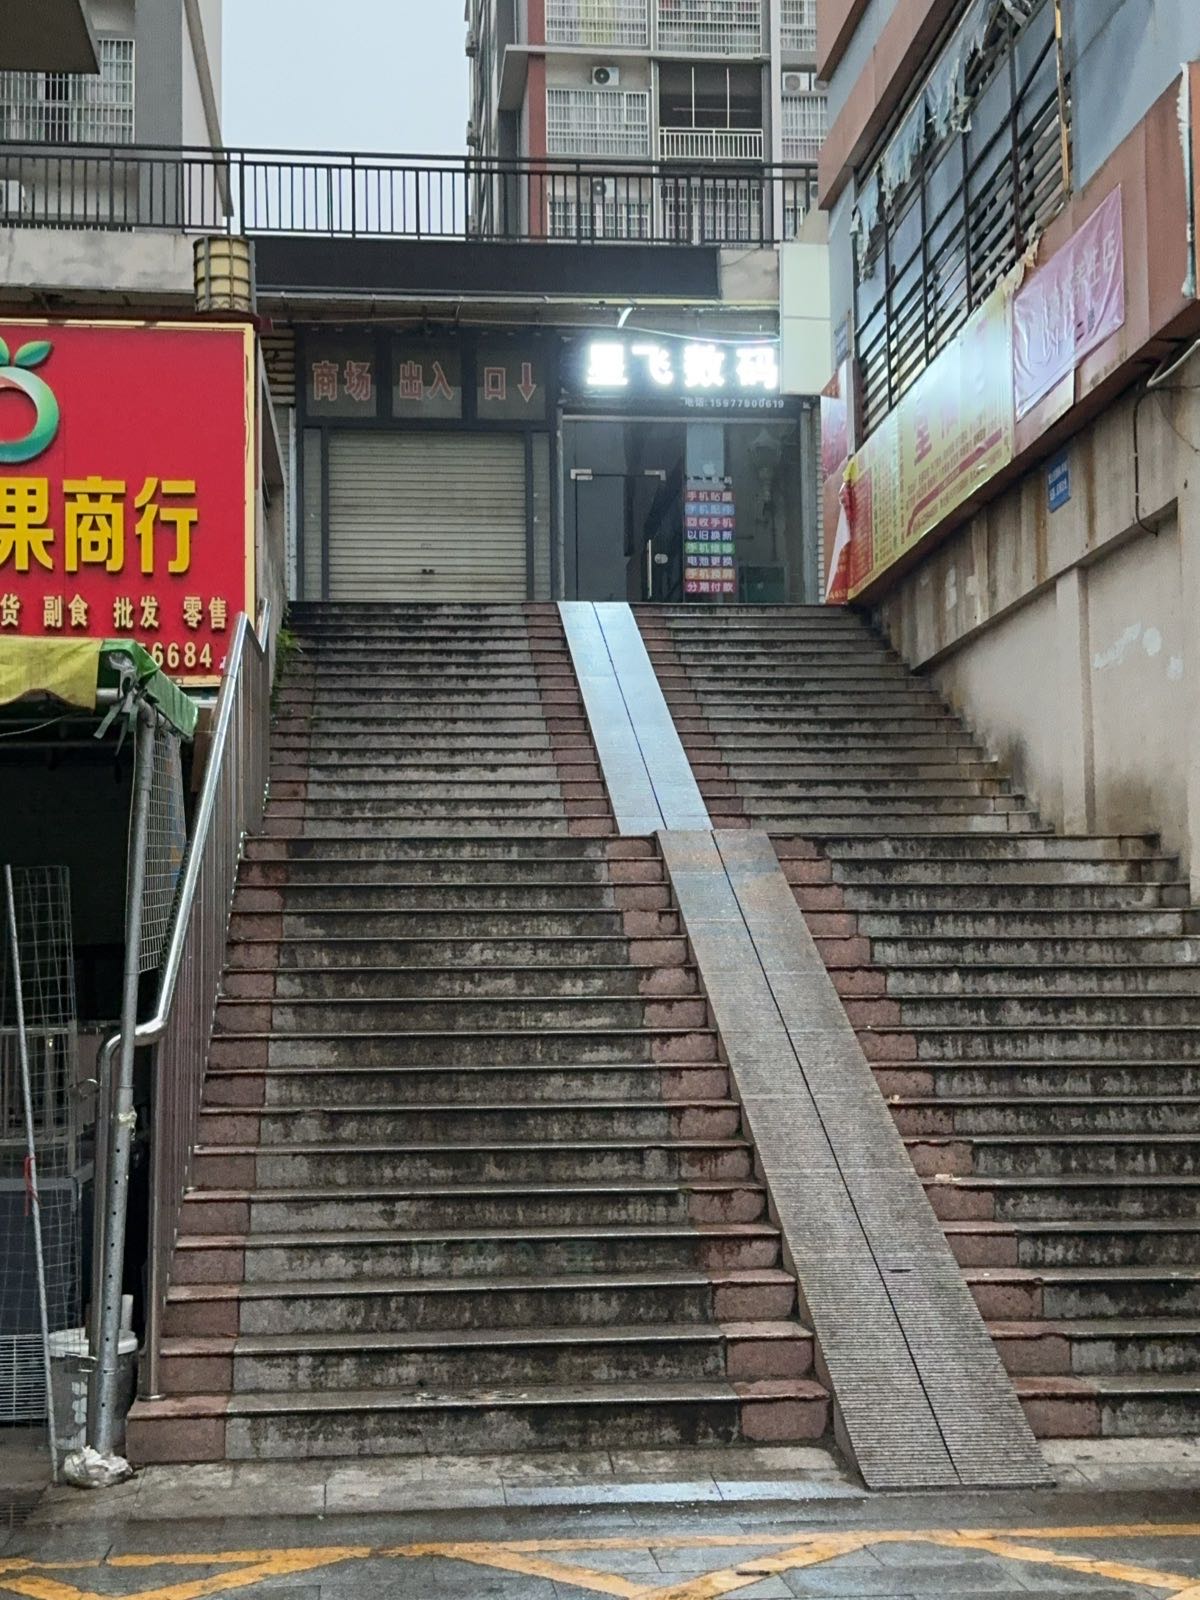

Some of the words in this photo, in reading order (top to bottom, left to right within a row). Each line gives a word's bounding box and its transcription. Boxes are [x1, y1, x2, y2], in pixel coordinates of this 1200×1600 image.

[312, 360, 372, 401] 商场
[399, 360, 454, 401] 出入
[484, 367, 506, 400] 口
[0, 476, 198, 573] 果商行
[687, 530, 733, 541] 以旧换新
[687, 582, 733, 593] 分期付款
[0, 593, 20, 626] 货
[43, 594, 88, 627] 副食
[113, 595, 159, 628] 批发
[183, 596, 227, 629] 零售
[140, 642, 212, 669] 6684
